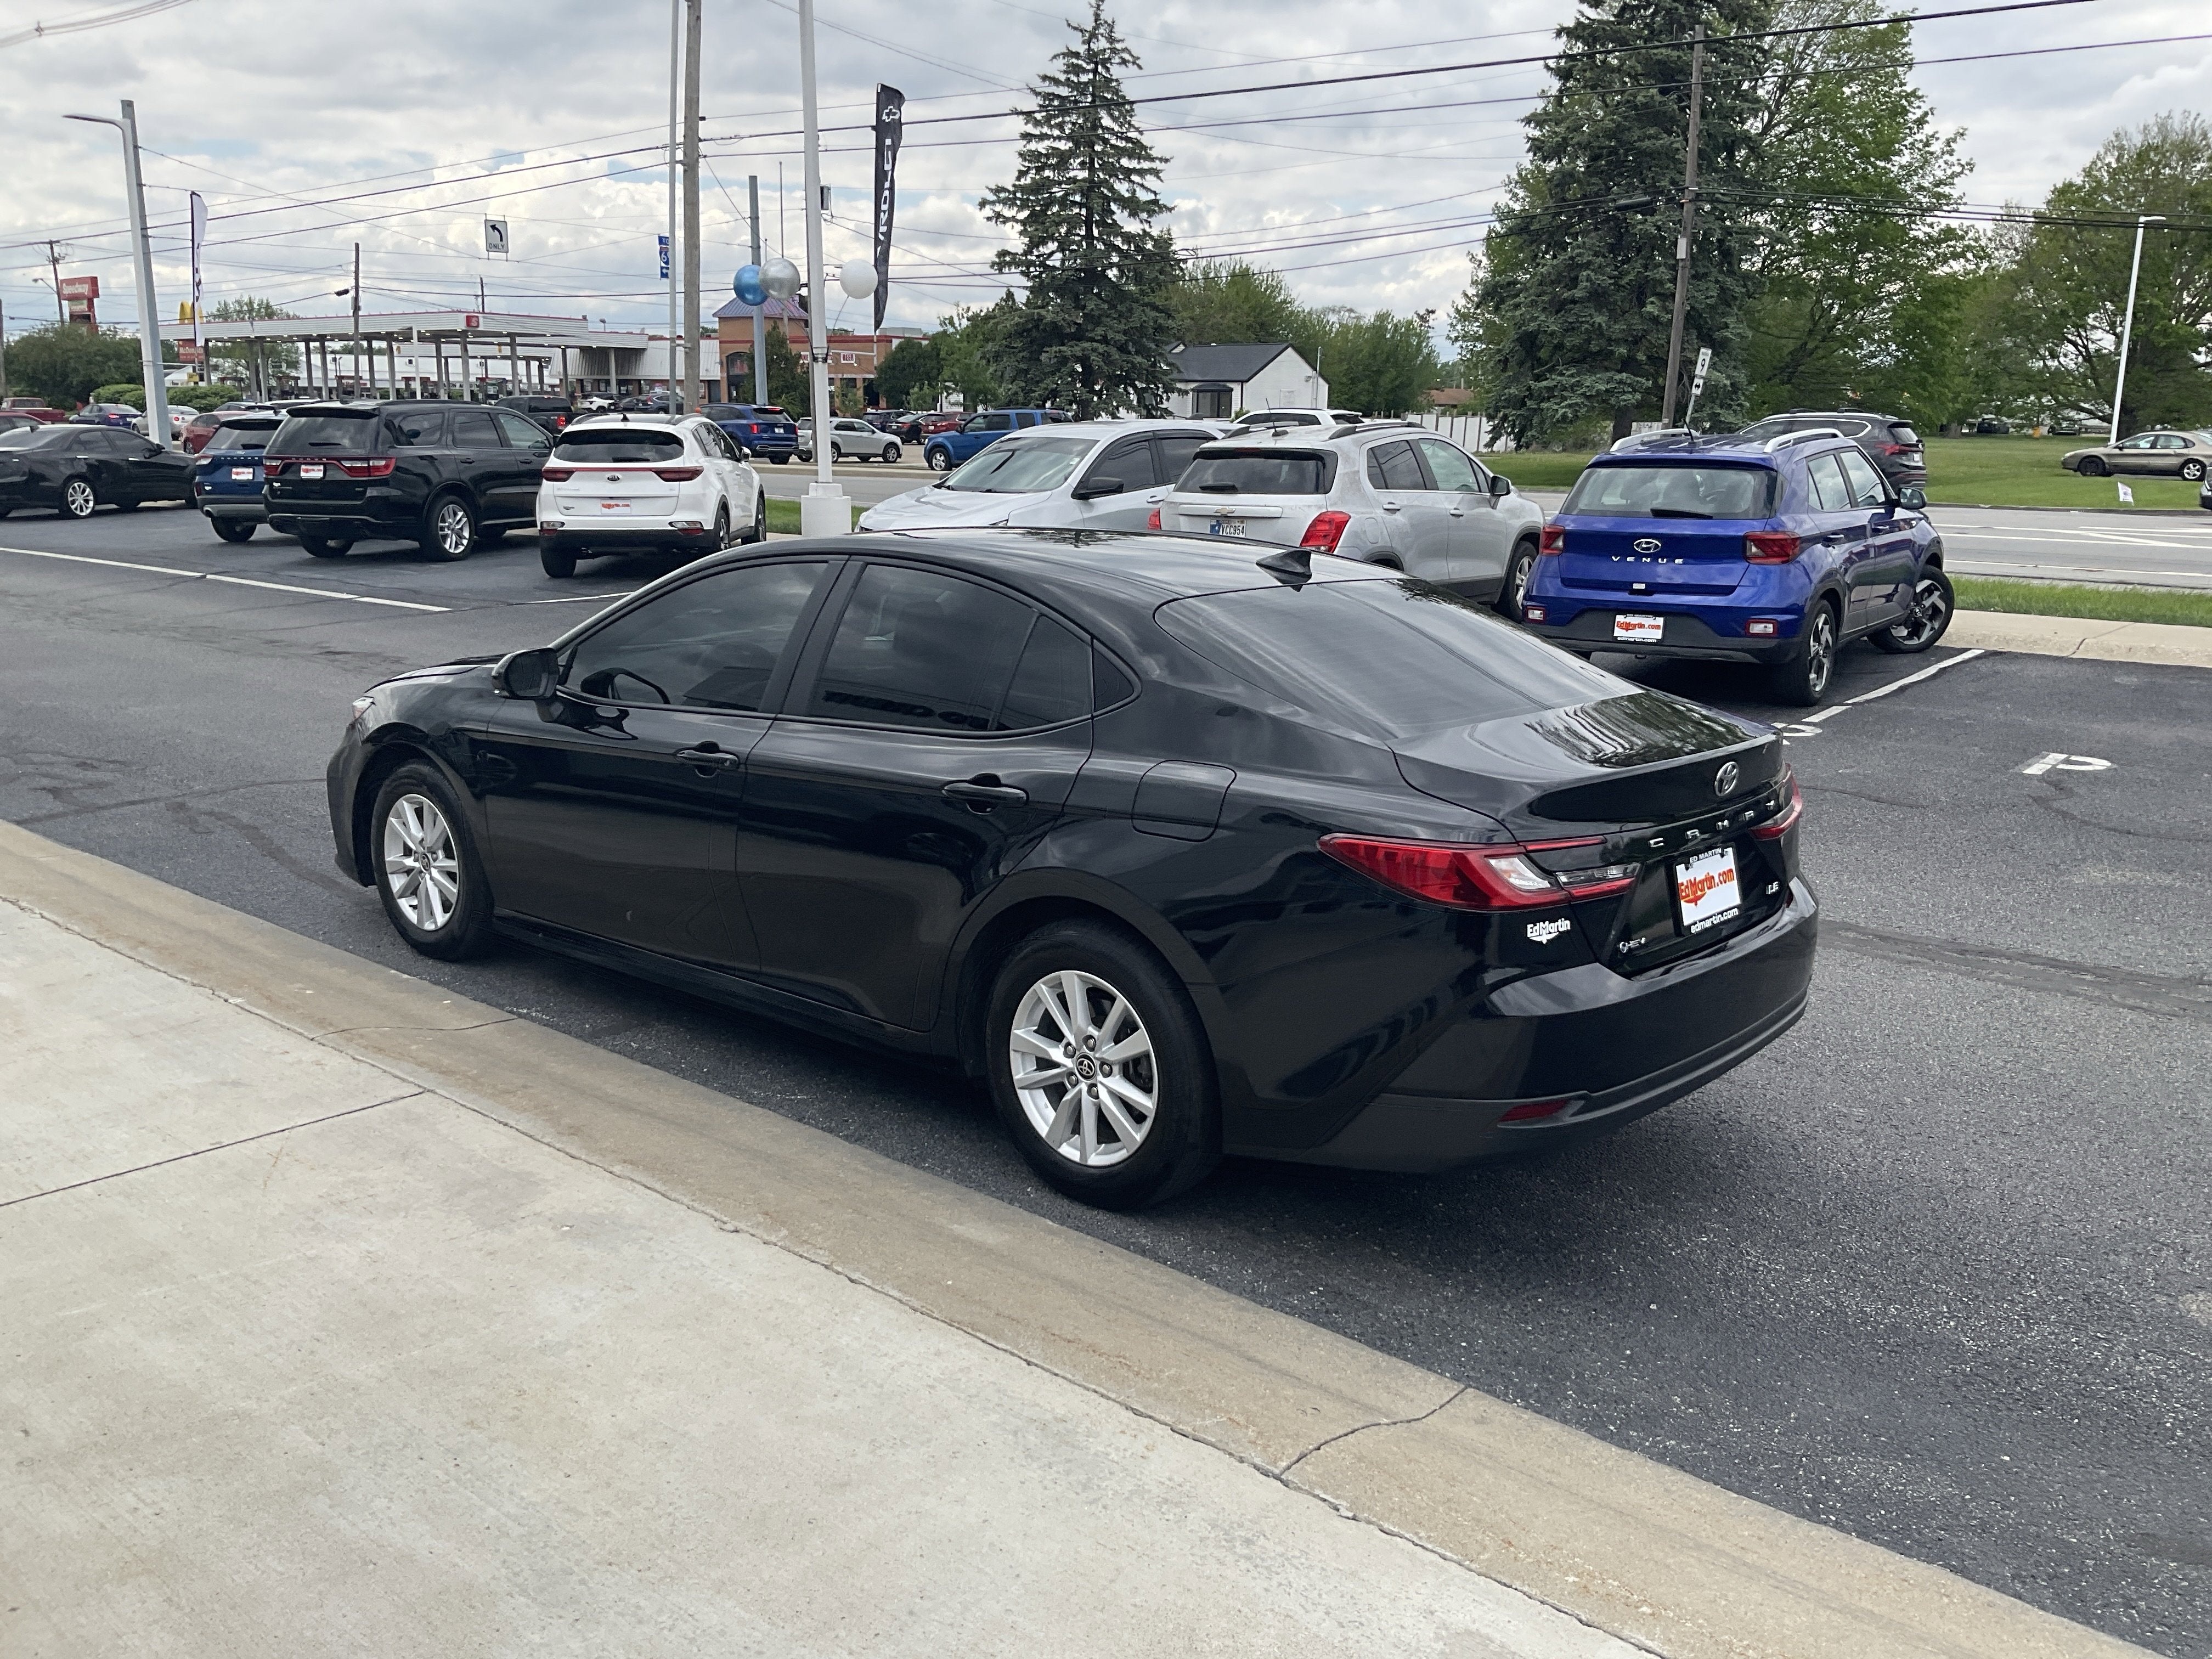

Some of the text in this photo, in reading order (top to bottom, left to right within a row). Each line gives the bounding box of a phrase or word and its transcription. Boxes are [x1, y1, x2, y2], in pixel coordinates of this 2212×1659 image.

[63, 282, 88, 296] Speedway
[1700, 358, 1706, 373] 9
[2022, 752, 2112, 775] P
[1699, 848, 1722, 860] MARTIN
[1690, 907, 1739, 933] edmartin.com
